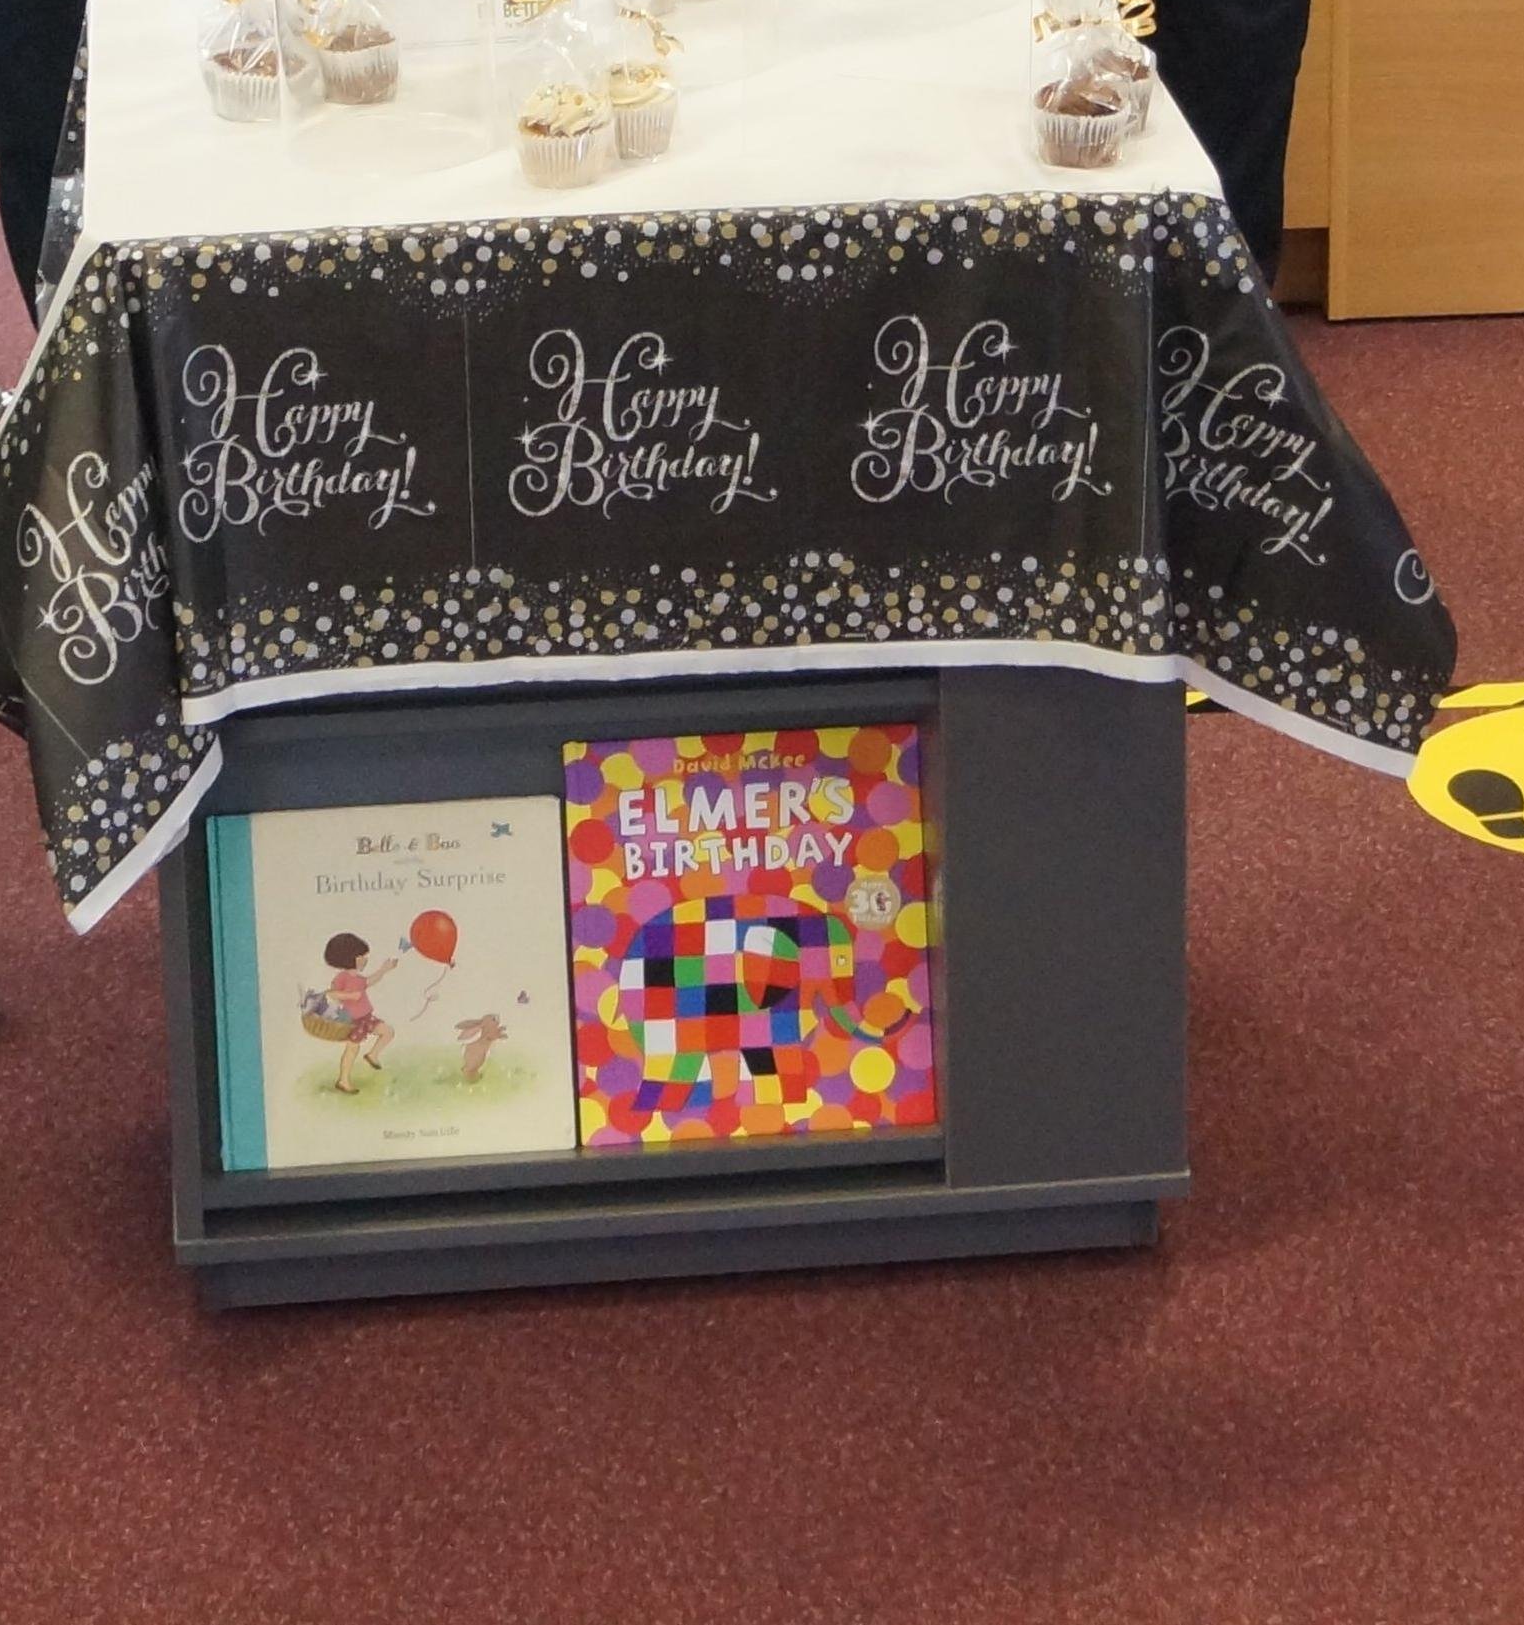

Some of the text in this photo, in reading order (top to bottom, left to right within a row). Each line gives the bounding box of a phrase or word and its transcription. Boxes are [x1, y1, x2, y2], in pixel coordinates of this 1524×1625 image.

[182, 343, 408, 459] Happy
[528, 328, 751, 443] Happy
[875, 314, 1091, 430] Happy
[1158, 325, 1332, 492] Happy
[178, 433, 437, 544] Birthday!
[507, 418, 777, 518] Birthday!
[850, 405, 1113, 504] Birthday!
[618, 775, 855, 836] ELMER'S
[673, 752, 807, 774] David McKee
[315, 867, 508, 896] Birthday Surprise
[625, 831, 853, 880] BIRTHDAY
